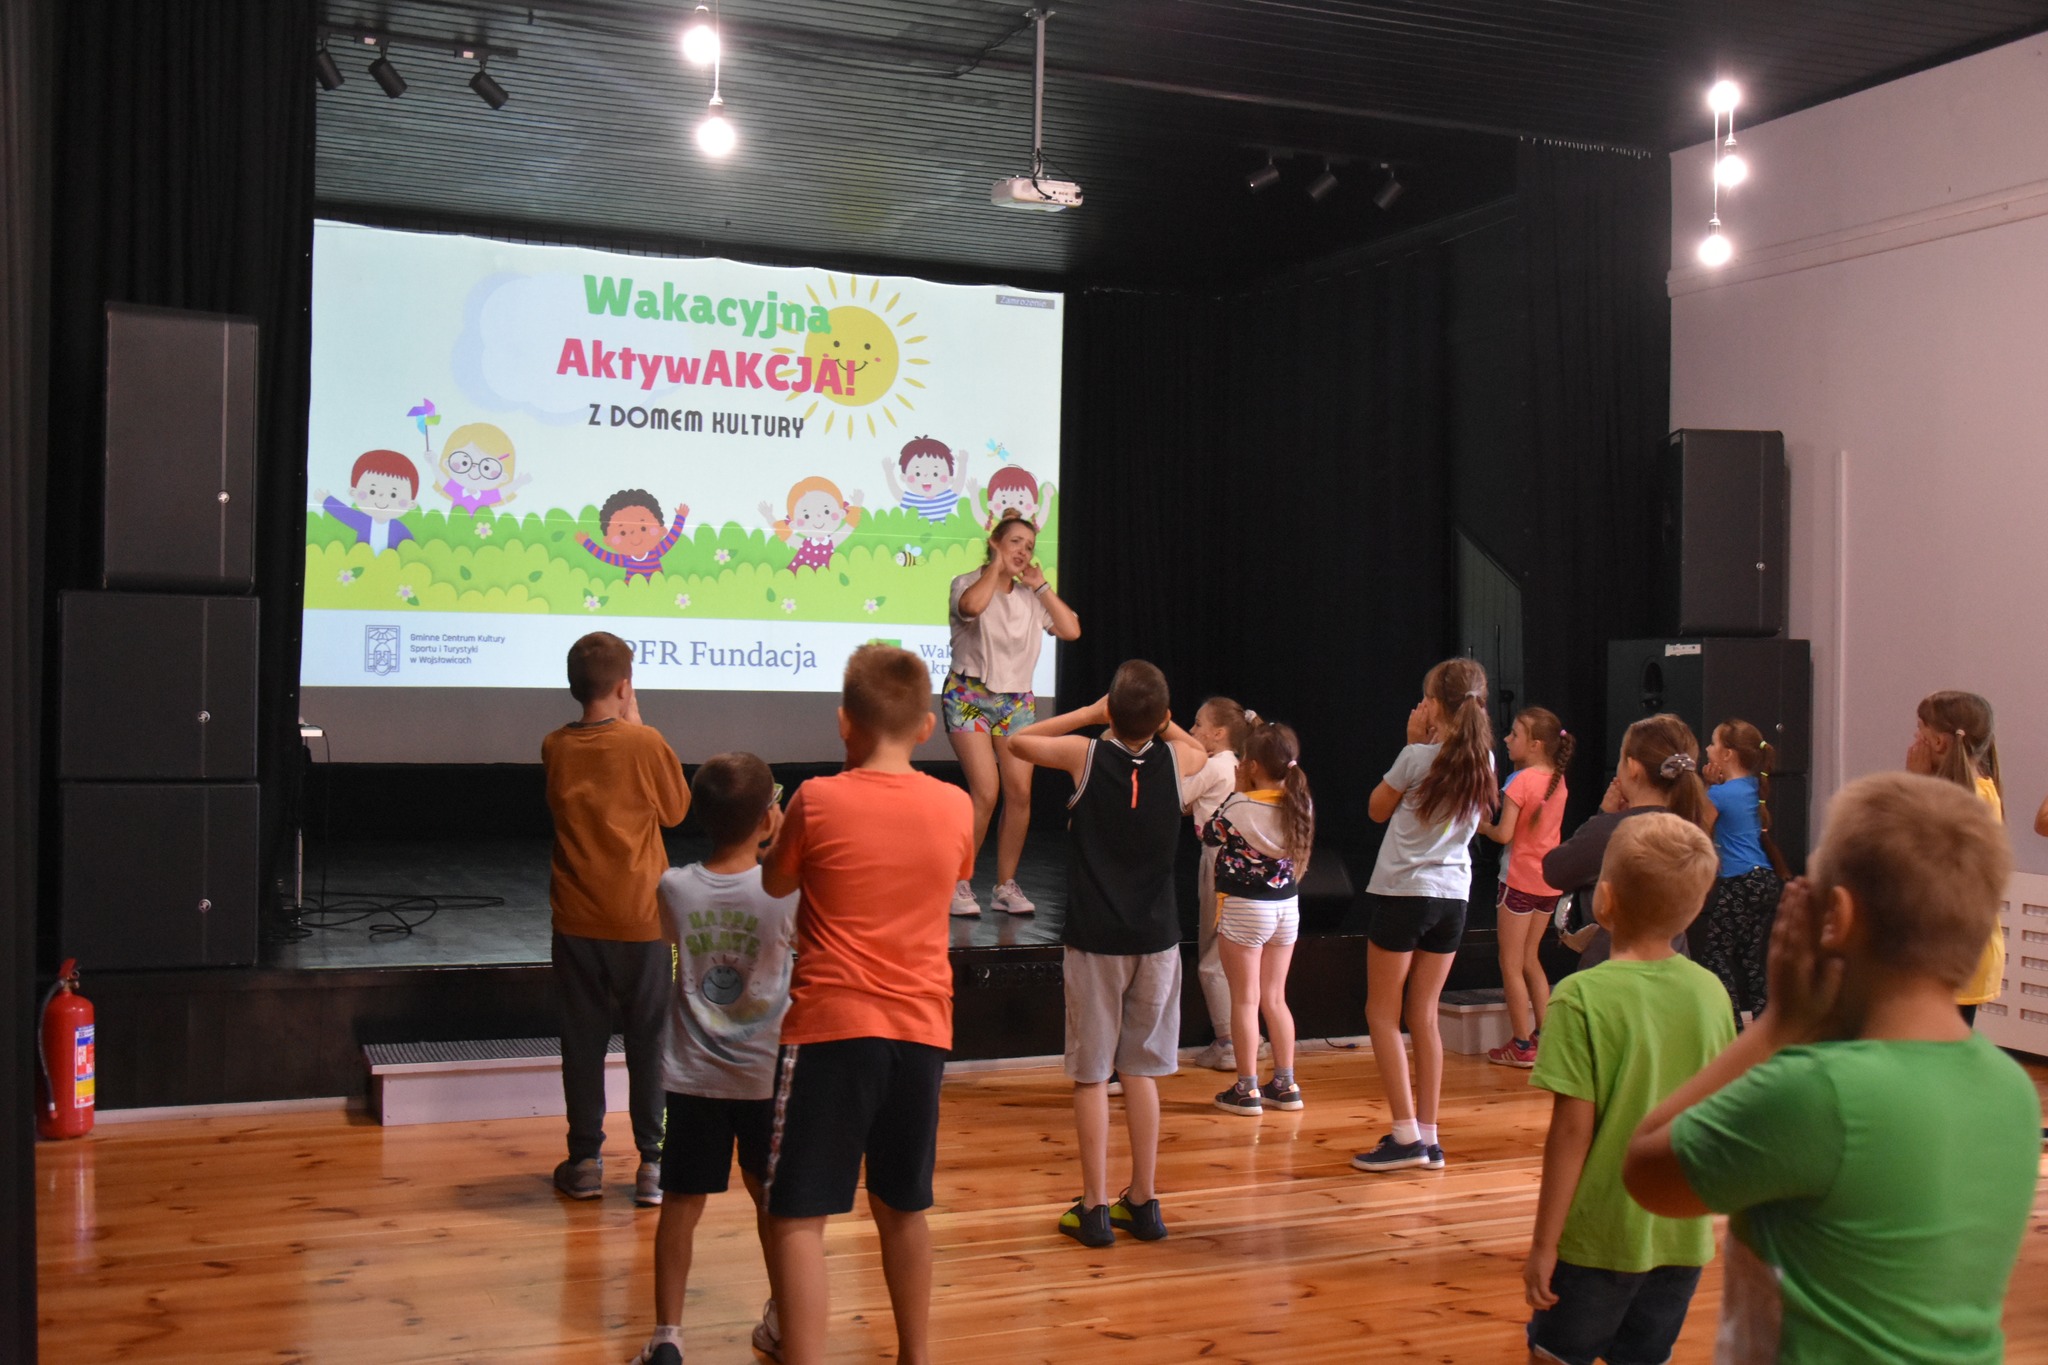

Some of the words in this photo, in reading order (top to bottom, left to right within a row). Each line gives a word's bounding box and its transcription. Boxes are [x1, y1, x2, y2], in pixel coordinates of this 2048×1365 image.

[584, 275, 832, 339] Wakacyjna
[556, 337, 856, 396] AktywAKCJA!
[588, 403, 601, 426] Z
[610, 405, 703, 432] DOMEM
[712, 411, 804, 439] KULTURY
[410, 633, 440, 642] Gminne
[442, 634, 475, 642] Centrum
[478, 635, 505, 644] Kultury
[410, 645, 437, 653] Sportu
[439, 645, 442, 653] i
[444, 645, 478, 654] Turystyki
[690, 641, 817, 675] Fundacja
